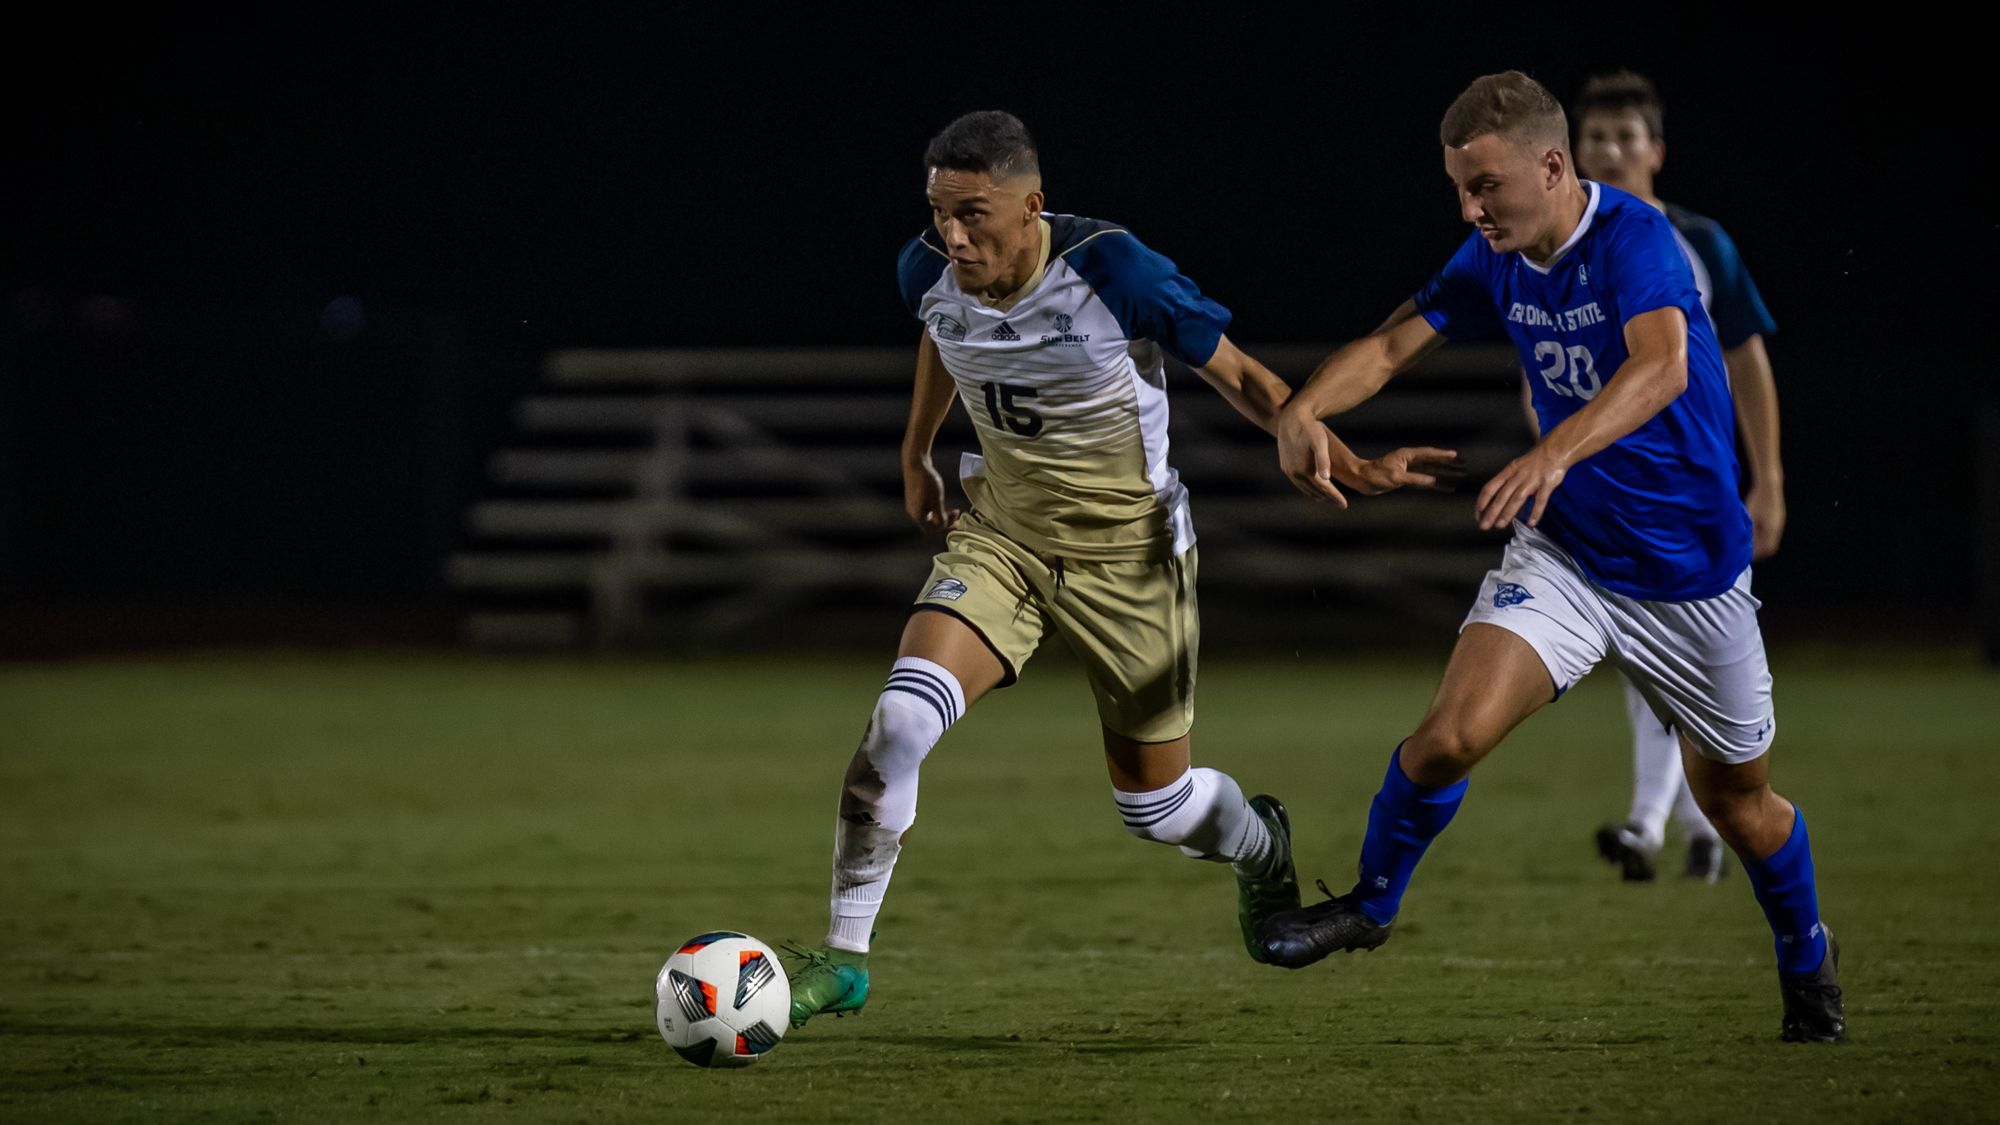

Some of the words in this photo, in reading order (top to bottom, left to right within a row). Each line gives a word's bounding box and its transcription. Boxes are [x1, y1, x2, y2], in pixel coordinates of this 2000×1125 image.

[1564, 301, 1606, 332] STATE
[991, 332, 1021, 341] adidas
[1040, 335, 1063, 344] SUN
[1064, 334, 1090, 343] BELT
[1534, 341, 1603, 401] 20
[980, 381, 1043, 438] 15
